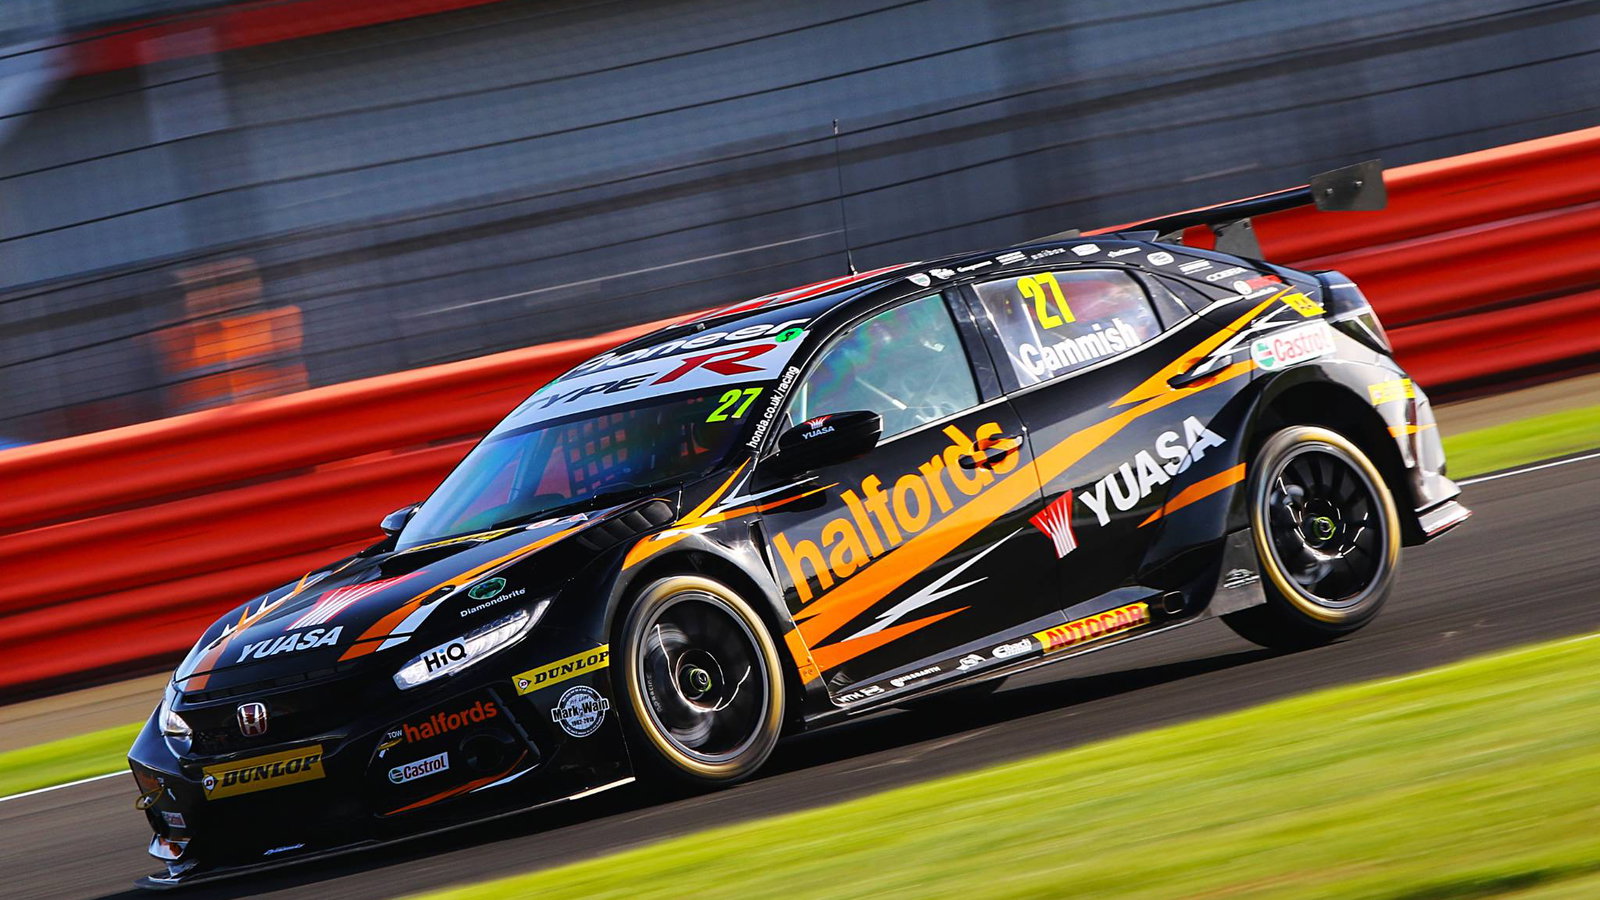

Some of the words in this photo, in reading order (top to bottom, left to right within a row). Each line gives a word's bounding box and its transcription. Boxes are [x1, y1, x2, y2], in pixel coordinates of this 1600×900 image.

[1017, 271, 1076, 329] 27
[1019, 317, 1141, 376] Cammish
[1272, 325, 1332, 362] Castrol
[705, 387, 764, 423] 27
[746, 365, 800, 449] honda.co.uk/racing
[802, 425, 836, 441] YUASA
[1078, 415, 1227, 528] YUASA
[773, 422, 1020, 605] halfords
[460, 588, 525, 617] Diamondbrite
[236, 626, 344, 663] YUASA
[1044, 605, 1146, 649] AUTOCAR
[423, 642, 468, 673] HiQ
[534, 651, 610, 685] DUNLOP
[403, 700, 497, 743] halfords
[553, 705, 579, 721] Mark
[582, 699, 608, 714] Wain
[387, 730, 402, 739] TOW
[221, 754, 322, 788] DUNLOP
[403, 755, 446, 780] Castrol
